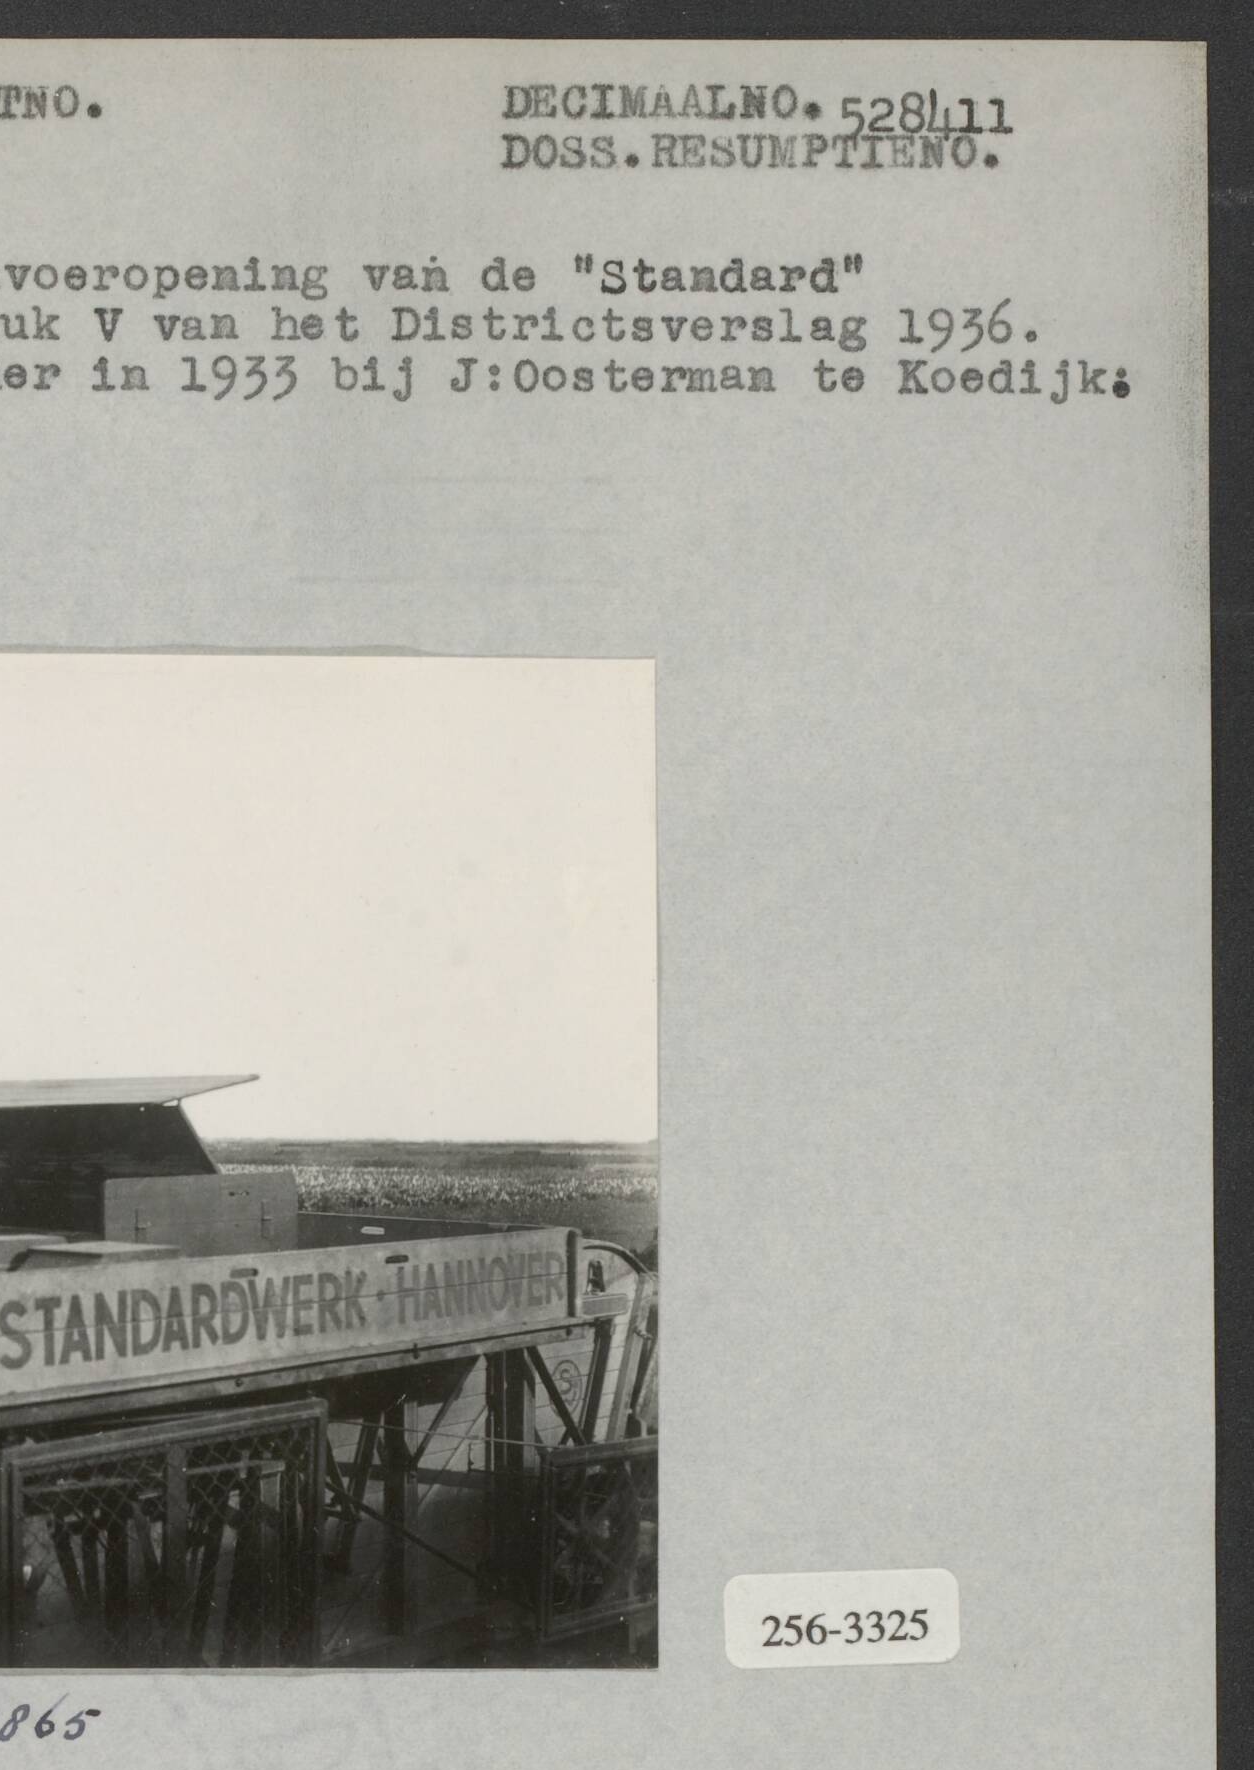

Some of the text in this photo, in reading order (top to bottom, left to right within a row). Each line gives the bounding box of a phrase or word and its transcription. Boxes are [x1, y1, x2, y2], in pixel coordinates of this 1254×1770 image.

[501, 82, 1014, 142] DECIMAALNO. 528411
[500, 131, 1000, 171] DOSS.RESUMPTIENO.
[362, 255, 451, 293] van
[480, 256, 536, 293] de
[573, 252, 864, 296] "Standard"
[93, 307, 124, 343] V
[153, 313, 240, 342] van
[270, 305, 360, 342] het
[390, 306, 868, 353] Districtsverslag
[898, 297, 1038, 354] 1936.
[91, 355, 150, 392] in
[180, 354, 298, 402] 1933
[330, 355, 413, 403] bij
[450, 357, 777, 394] J:Oosterman
[813, 358, 865, 393] te
[395, 1251, 569, 1324] HANNOVER
[761, 1607, 929, 1648] 256-3325
